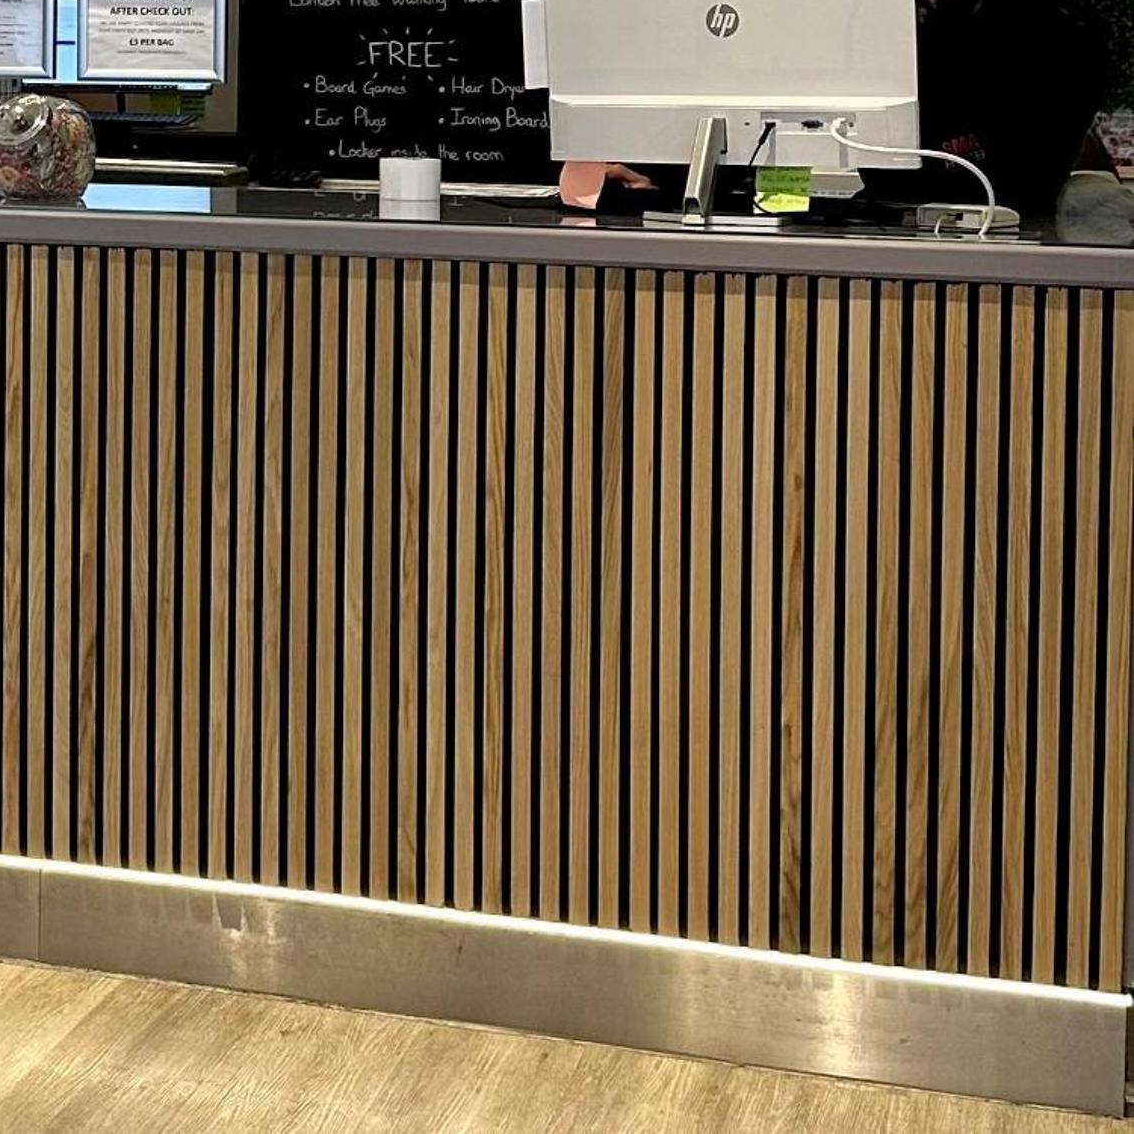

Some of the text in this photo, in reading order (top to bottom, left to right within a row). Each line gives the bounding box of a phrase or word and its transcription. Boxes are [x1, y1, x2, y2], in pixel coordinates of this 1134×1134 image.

[110, 7, 192, 16] AFTER CHECK OUT
[708, 3, 737, 37] hp
[368, 40, 446, 68] FREE
[315, 74, 357, 95] Board
[362, 77, 408, 98] Games
[451, 75, 484, 95] Hair
[314, 106, 550, 133] Ear Plugs Ironing Board
[338, 139, 382, 159] Locker
[438, 143, 459, 161] the
[465, 149, 505, 161] room
